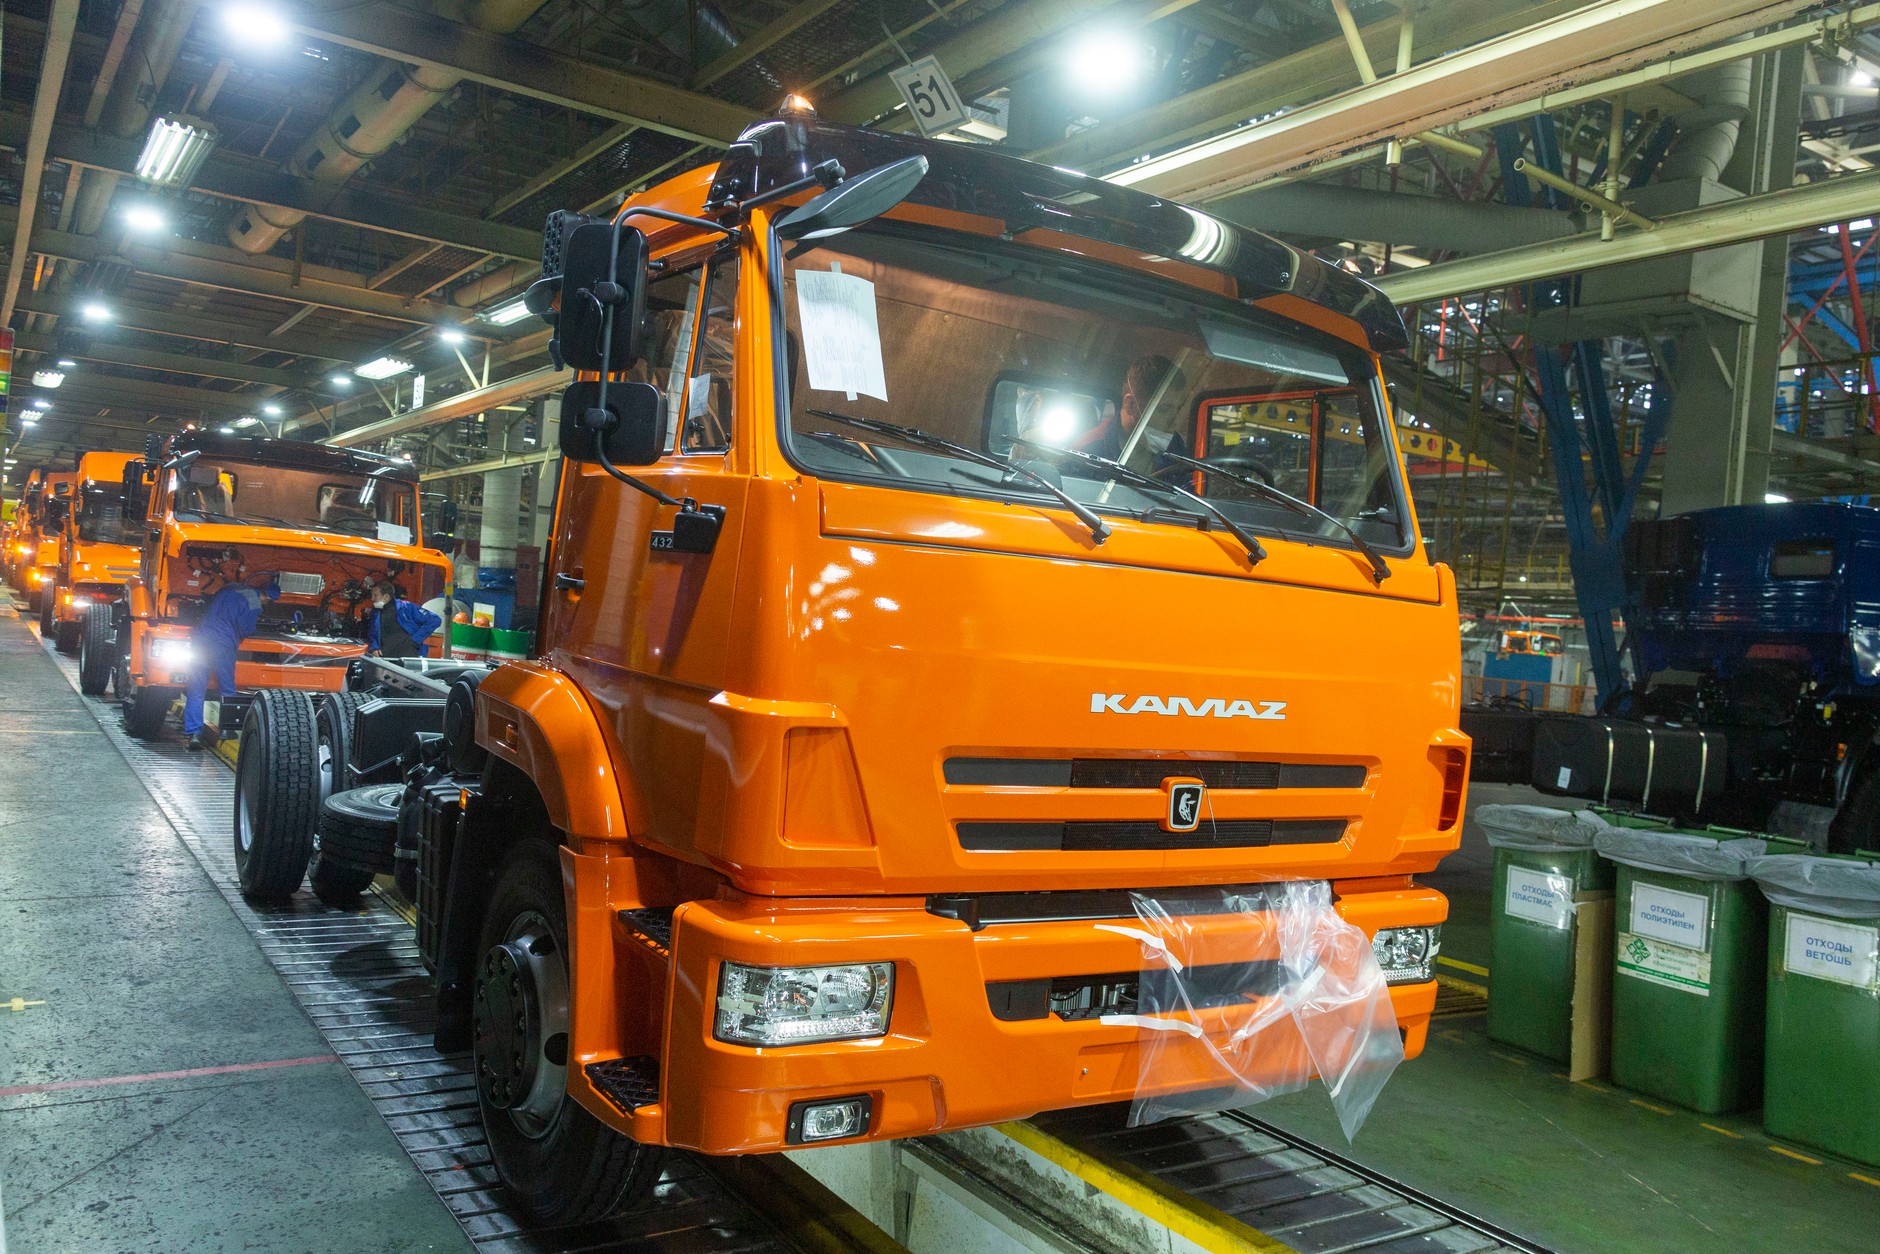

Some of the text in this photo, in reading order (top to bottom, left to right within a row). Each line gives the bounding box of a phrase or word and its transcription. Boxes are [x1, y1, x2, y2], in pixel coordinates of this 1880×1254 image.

[908, 75, 951, 118] 51
[1091, 693, 1287, 720] KAMAZ
[1522, 884, 1554, 898] ОТХОДЫ
[1650, 904, 1685, 918] ОТХОДЫ
[1640, 912, 1694, 930] ПОЛИЭТИЛЕН
[1806, 937, 1852, 953] ОТХОДЫ
[1806, 949, 1852, 966] ВЕТОШЬ
